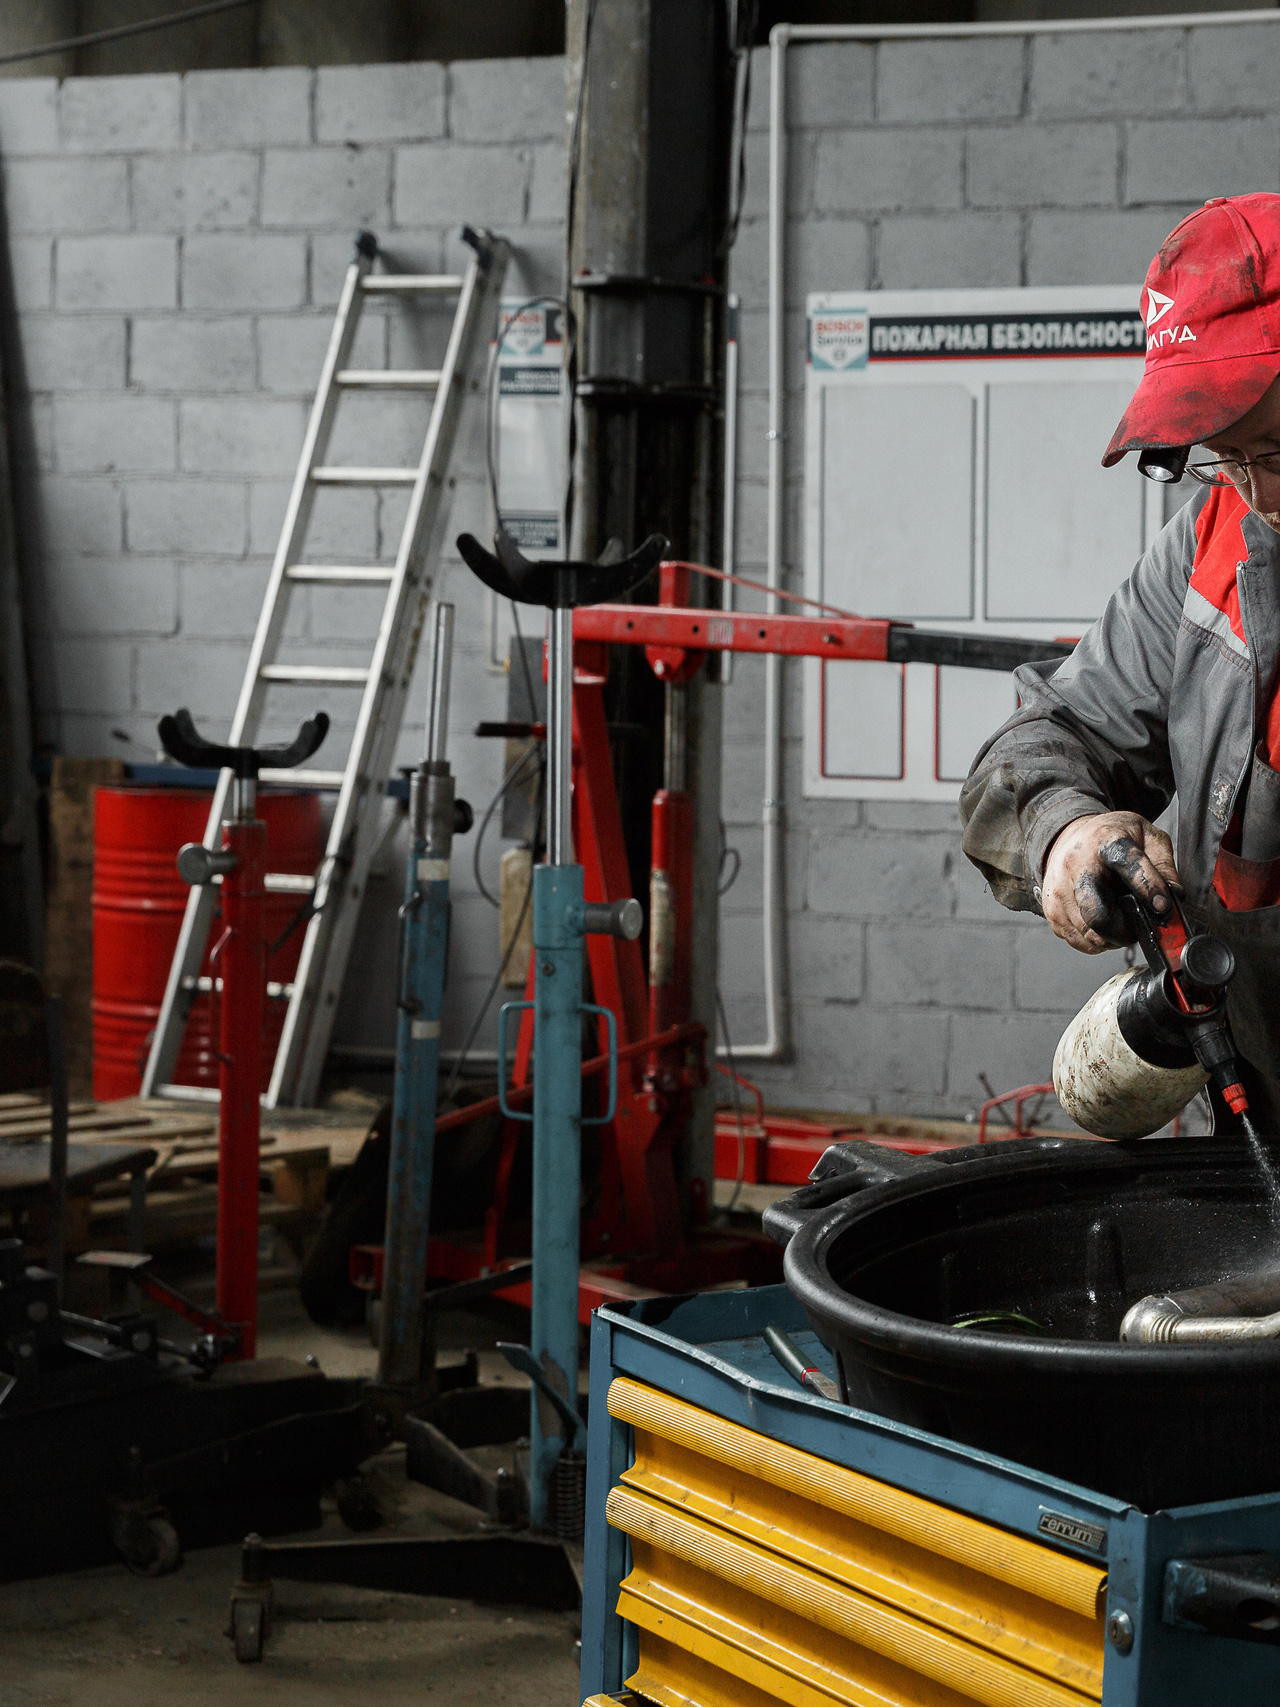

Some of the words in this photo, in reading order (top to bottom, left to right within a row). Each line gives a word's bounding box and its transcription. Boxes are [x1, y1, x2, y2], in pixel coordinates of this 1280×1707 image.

[872, 323, 988, 352] ПОЖАРНАЯ
[990, 320, 1145, 350] БЕЗОПАСНОСТ
[1041, 1514, 1093, 1544] Ferrum
